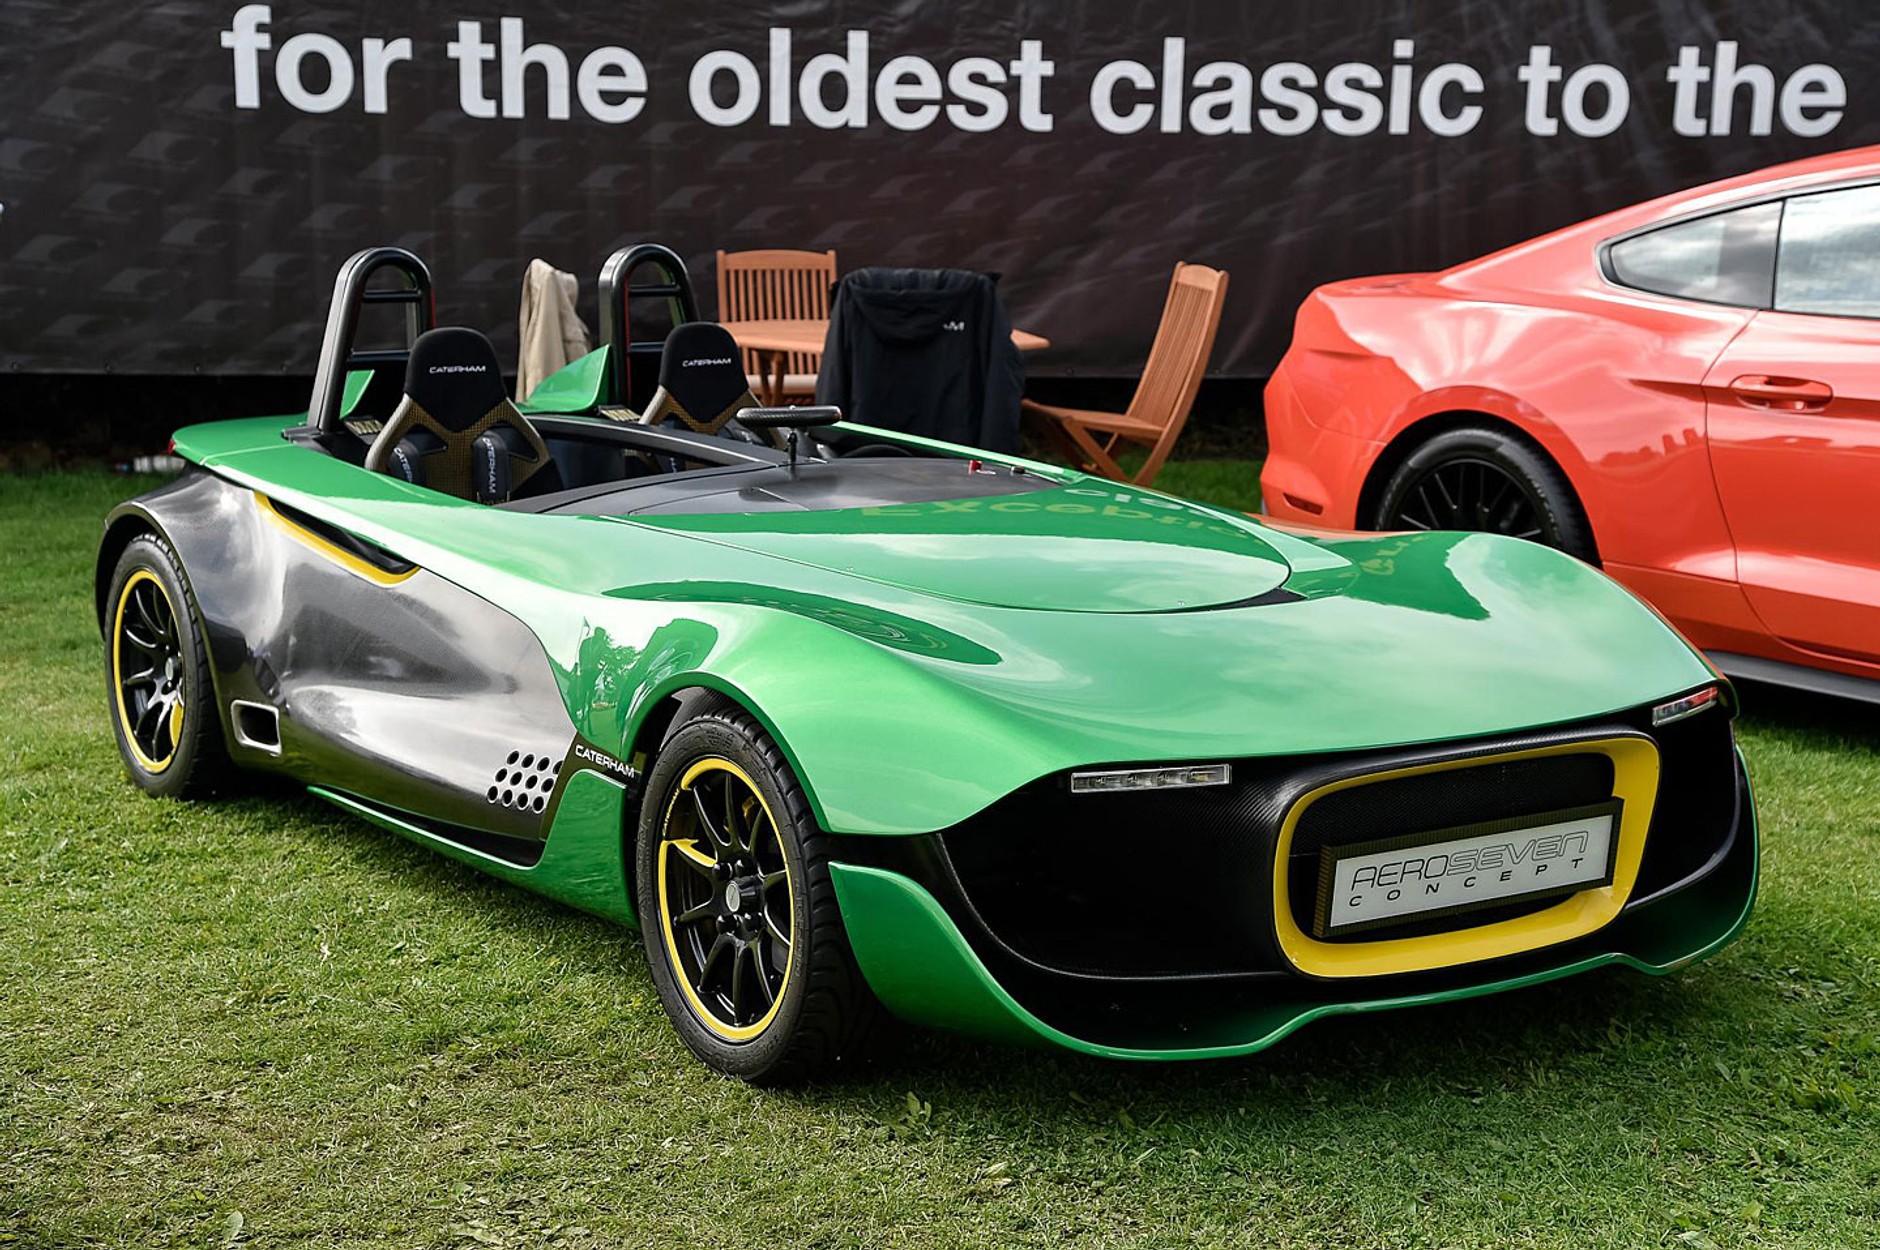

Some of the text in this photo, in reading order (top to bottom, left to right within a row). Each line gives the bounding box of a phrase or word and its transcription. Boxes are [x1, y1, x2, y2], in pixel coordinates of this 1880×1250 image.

[221, 4, 1847, 137] for the oldest classic to the
[429, 365, 486, 374] CATERHAM
[682, 358, 731, 367] CATERHAM
[574, 744, 636, 779] CATERHAM
[1349, 857, 1584, 907] CONCEPT
